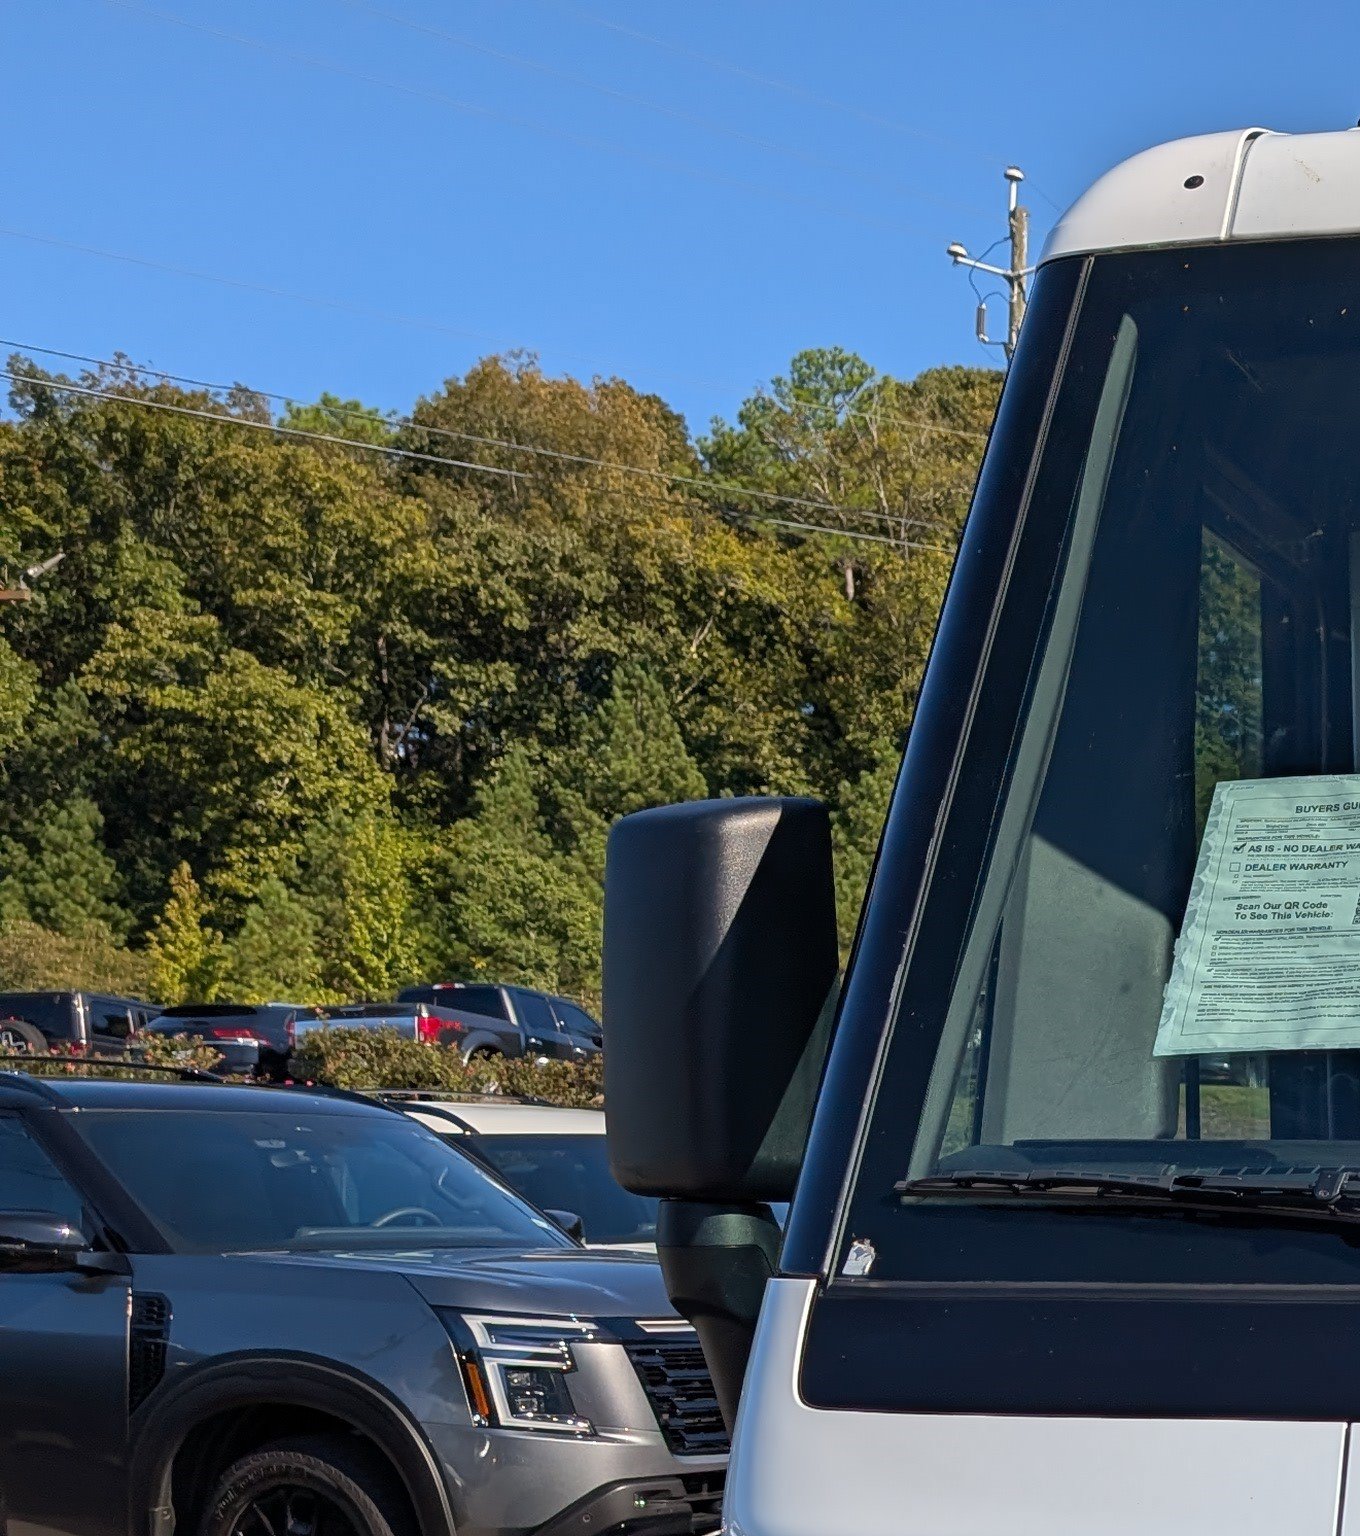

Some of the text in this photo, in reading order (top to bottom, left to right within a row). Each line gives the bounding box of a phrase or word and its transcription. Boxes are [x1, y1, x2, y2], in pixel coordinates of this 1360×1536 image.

[1295, 803, 1340, 814] BUYERS
[1247, 845, 1262, 853] AS
[1264, 844, 1275, 853] IS
[1283, 844, 1299, 853] NO
[1301, 843, 1344, 853] DEALER
[1244, 861, 1348, 872] DEALER WARRANTY
[1236, 901, 1328, 911] Scan Our QR Code
[1234, 910, 1333, 920] To See This Vehicle:
